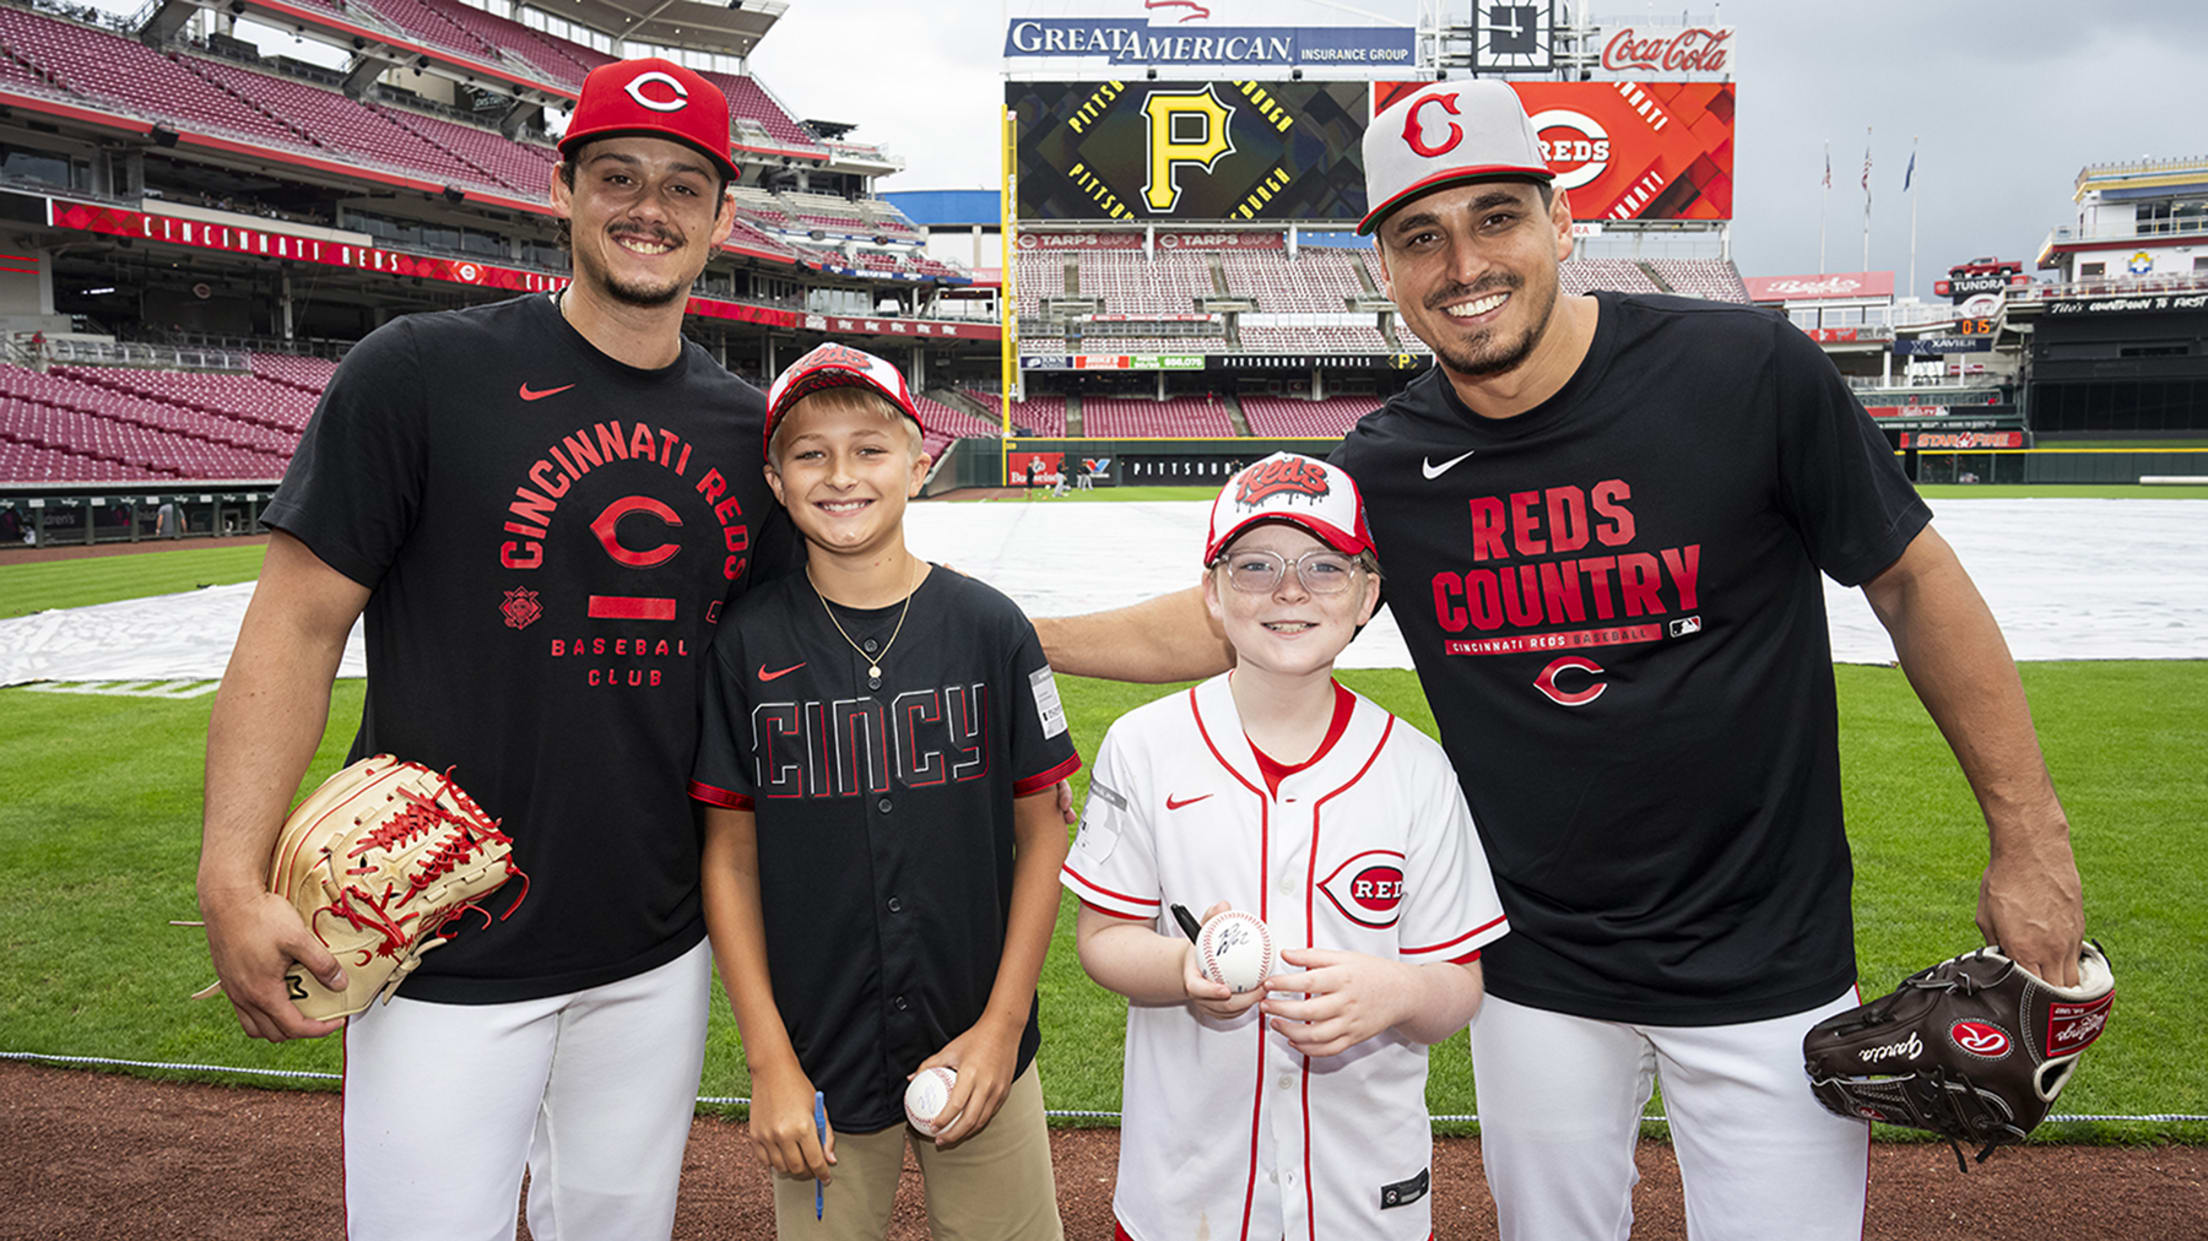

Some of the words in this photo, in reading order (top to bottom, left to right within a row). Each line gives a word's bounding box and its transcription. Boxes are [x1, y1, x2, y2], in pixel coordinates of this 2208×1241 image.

[1011, 22, 1131, 54] GREAT
[1119, 31, 1292, 62] AMERICAN
[1301, 49, 1366, 62] INSURANCE
[1369, 49, 1409, 62] GROUP
[1602, 28, 1733, 72] Coca-Cola
[1232, 80, 1294, 133] BURGH
[1230, 167, 1291, 220] BURGH
[143, 216, 319, 261] CINCINNATI
[343, 246, 398, 272] REDS
[1041, 234, 1097, 246] TARPS
[1181, 234, 1238, 246] TARPS
[1954, 279, 2005, 291] TUNDRA
[1223, 357, 1306, 367] PITTSBURGH
[1315, 357, 1371, 367] PIRATES
[1932, 339, 1976, 348] XAVIER
[500, 420, 692, 569] CINCINNATI
[695, 467, 749, 580] REDS
[1234, 456, 1328, 503] Reds
[1469, 478, 1636, 562] REDS
[1431, 544, 1701, 633] COUNTRY
[1452, 639, 1524, 653] CINCINNATI
[1530, 634, 1567, 648] REDS
[1574, 628, 1648, 645] BASEBALL
[588, 668, 662, 686] CLUB
[751, 683, 991, 799] CINCY
